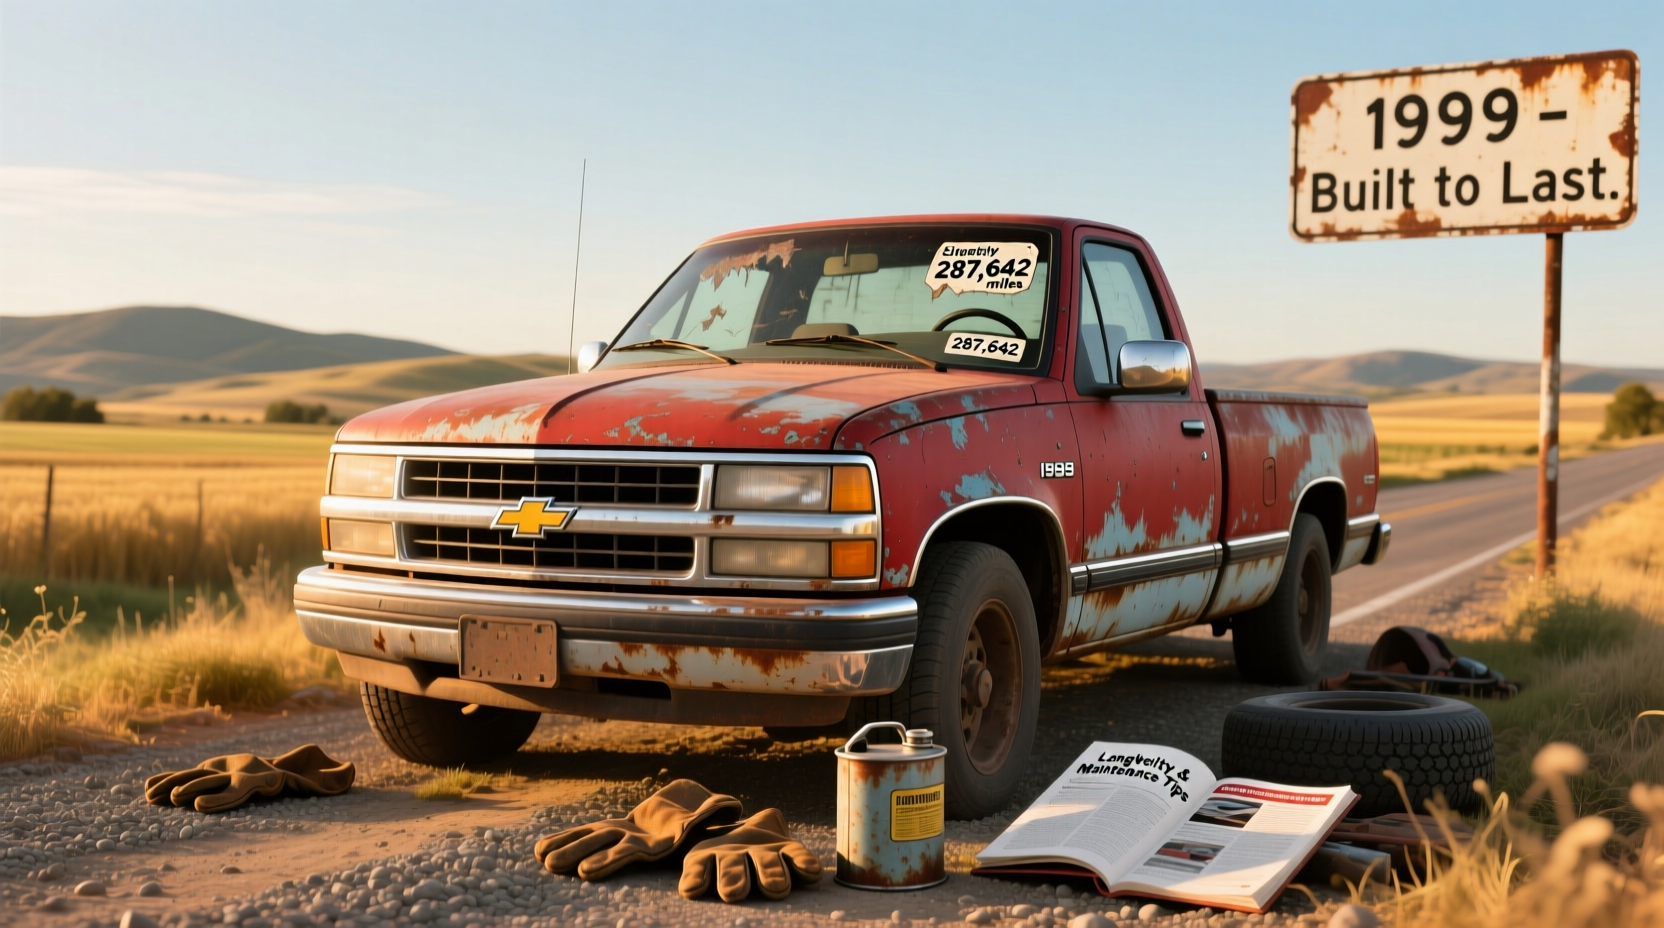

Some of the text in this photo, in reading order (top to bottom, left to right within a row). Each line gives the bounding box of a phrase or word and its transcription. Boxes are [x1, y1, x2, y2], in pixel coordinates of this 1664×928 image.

[1366, 87, 1519, 150] 1999
[1311, 157, 1620, 213] Built to Last.
[934, 258, 1032, 283] 287,642
[951, 337, 1019, 356] 287,642
[1040, 462, 1074, 478] 1999
